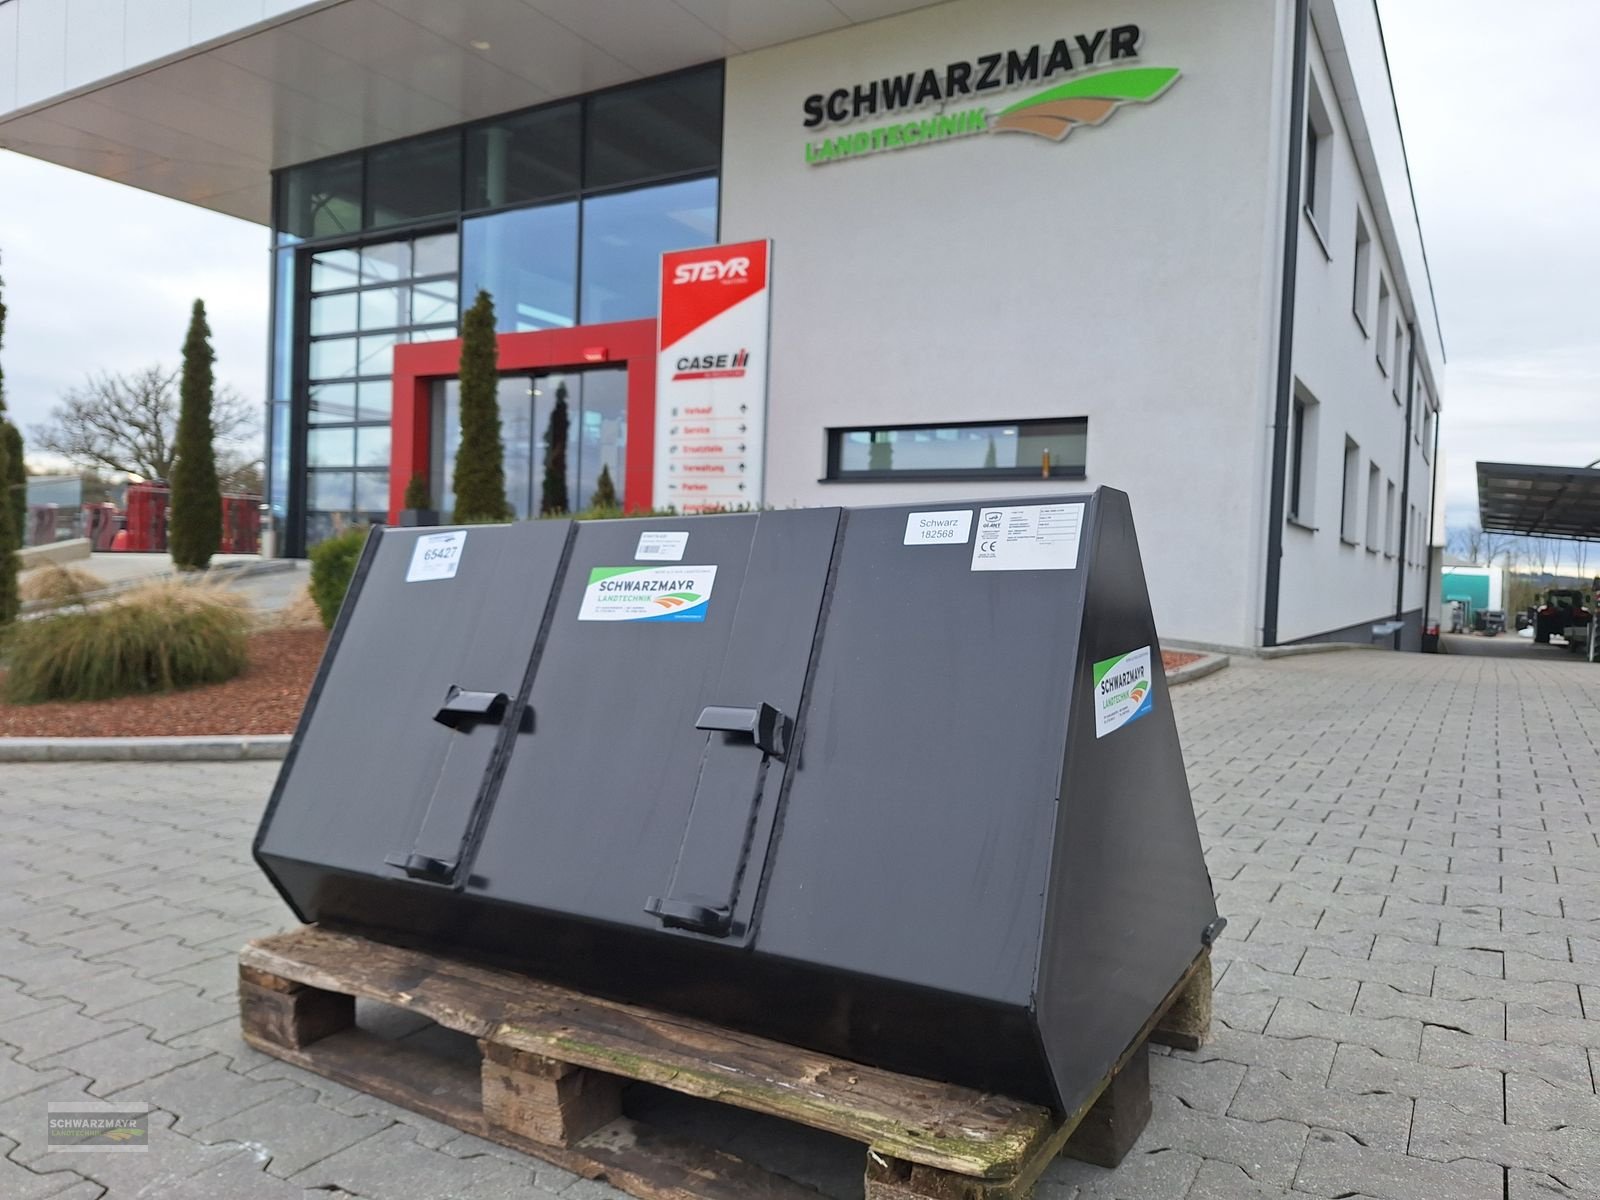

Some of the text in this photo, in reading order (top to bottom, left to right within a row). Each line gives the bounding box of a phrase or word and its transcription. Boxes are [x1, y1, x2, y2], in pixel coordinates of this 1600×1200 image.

[803, 24, 1141, 128] SCHWARZMAYR
[805, 107, 988, 164] LANDTECHNIK
[673, 257, 750, 285] STEYR
[677, 354, 728, 370] CASE
[919, 518, 958, 528] Schwarz
[921, 530, 954, 539] 182568
[424, 546, 458, 561] 65427
[599, 580, 695, 592] SCHWARZMAYR
[598, 594, 652, 602] LANDTECHNIK
[1101, 665, 1145, 695] SCHWARZMAYR
